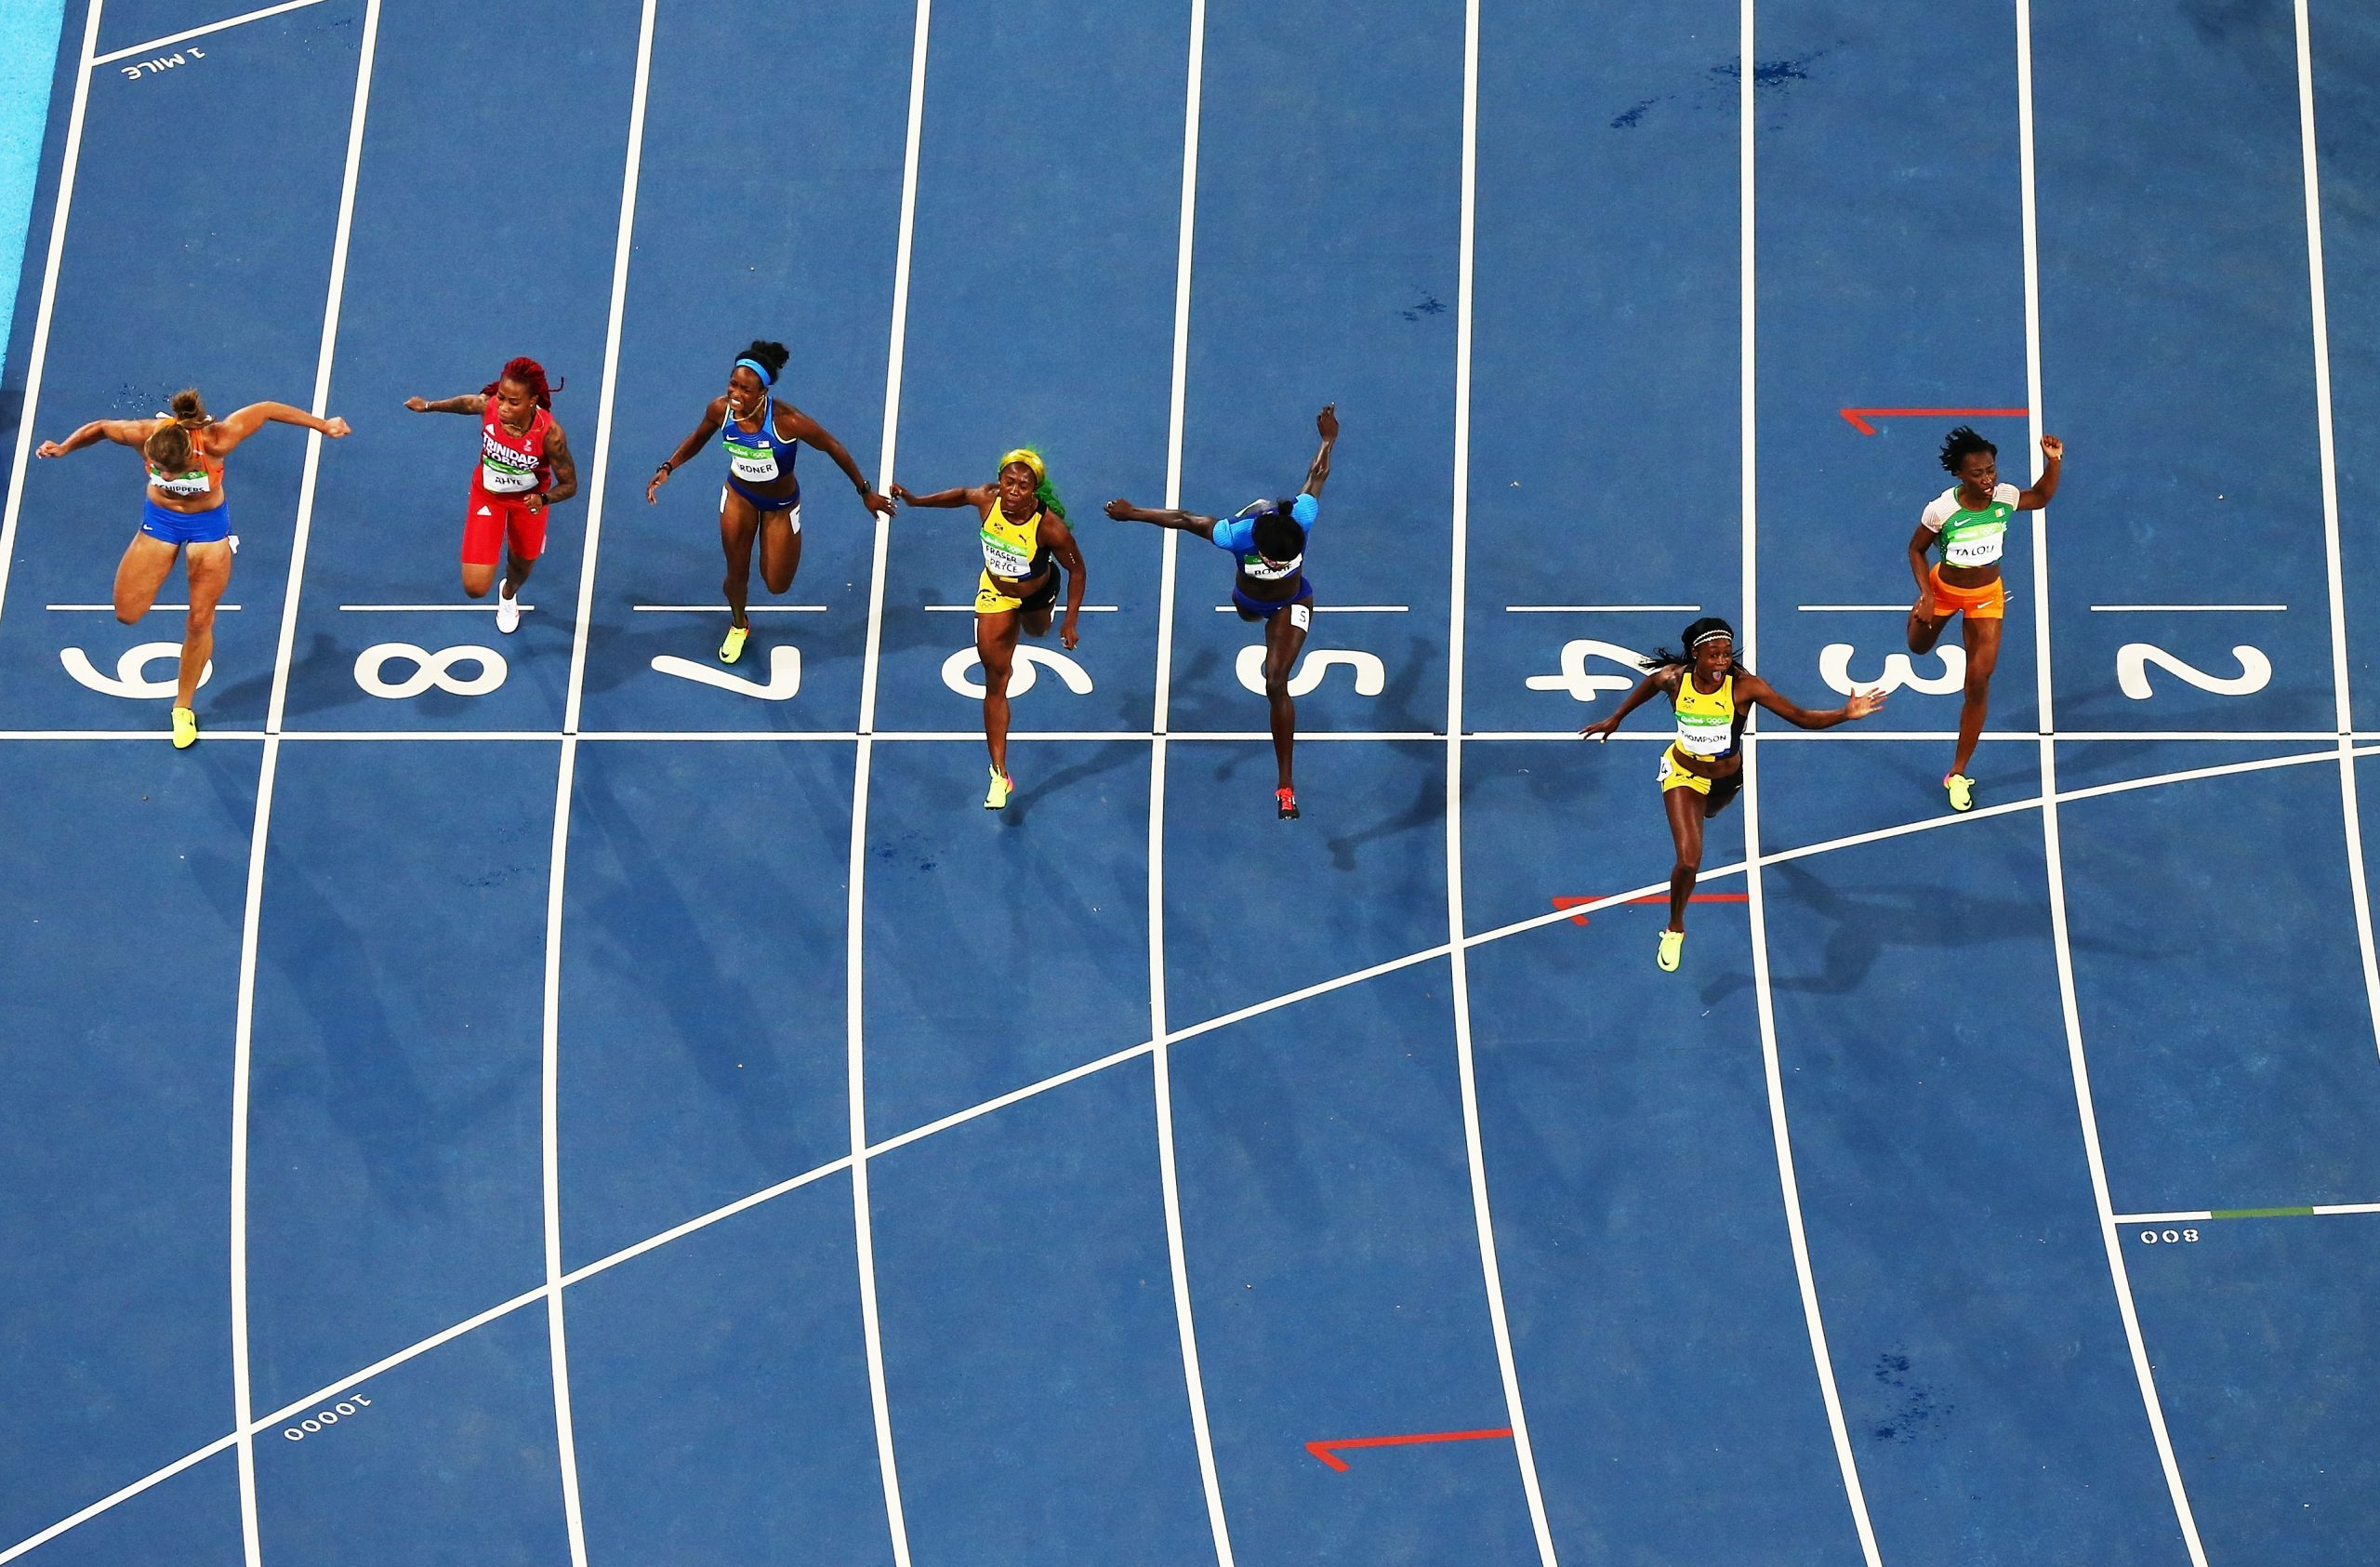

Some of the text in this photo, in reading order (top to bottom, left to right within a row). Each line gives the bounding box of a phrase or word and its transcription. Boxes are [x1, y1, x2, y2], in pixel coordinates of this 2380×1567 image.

[121, 47, 205, 80] 1 MILE
[483, 431, 539, 465] TRINIDAD
[737, 463, 774, 474] RDNER
[495, 476, 523, 486] AHYE
[985, 545, 1017, 564] FRASER
[990, 558, 1019, 573] PRYCE
[60, 642, 214, 699] 9
[354, 643, 508, 700] 8
[651, 645, 801, 701] 7
[941, 644, 1094, 700] 6
[1236, 644, 1385, 697] 5
[1526, 639, 1663, 702] 4
[1818, 644, 1967, 699] 3
[2116, 643, 2272, 700] 2
[1681, 730, 1726, 743] THOMPSON
[1661, 763, 1669, 775] 4
[2140, 1228, 2200, 1244] 800
[284, 1393, 372, 1441] 10000
